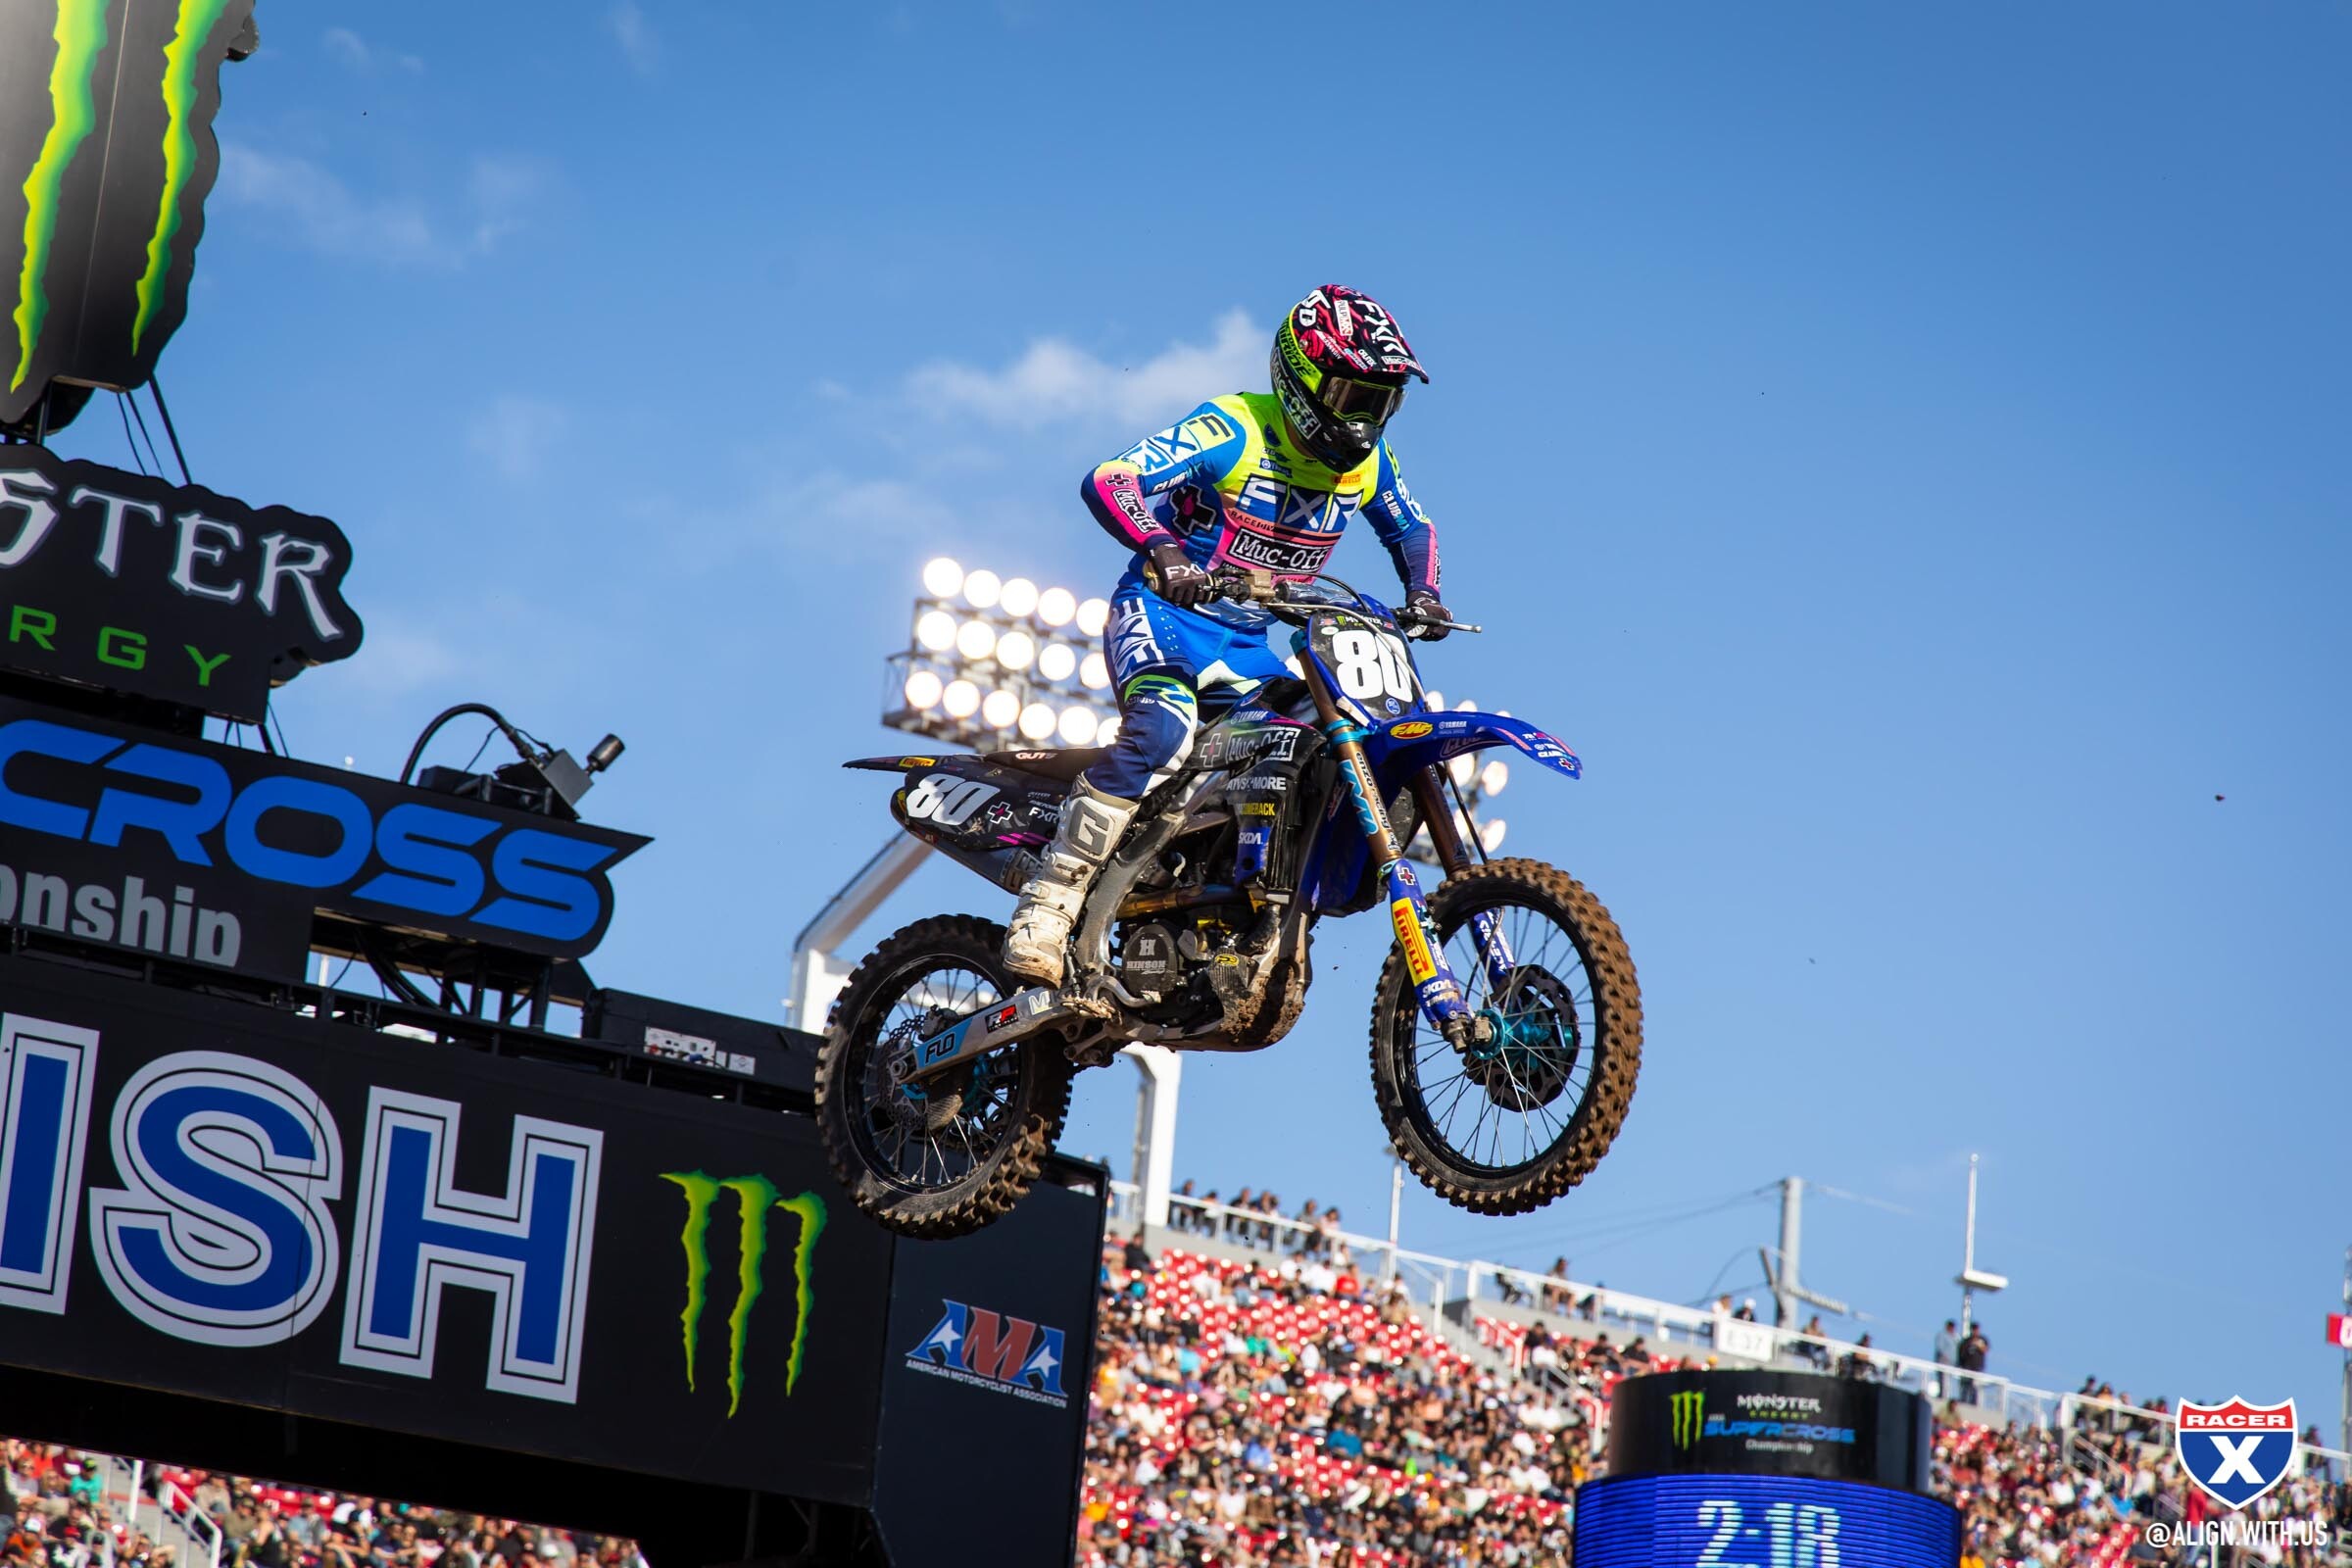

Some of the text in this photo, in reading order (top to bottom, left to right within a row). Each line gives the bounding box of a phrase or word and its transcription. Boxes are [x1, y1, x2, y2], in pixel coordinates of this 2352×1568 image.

[1241, 476, 1363, 531] FXR
[1237, 535, 1328, 569] Muc-Off
[1332, 630, 1413, 703] 80
[906, 773, 1001, 826] 80
[0, 719, 618, 942] CROSS
[1394, 906, 1430, 976] PIRELLI
[905, 1298, 1069, 1398] AMA
[906, 1358, 1067, 1409] AMERICAN MOTORCYCLIST ASSOCIATION
[1737, 1393, 1821, 1413] MONSTER
